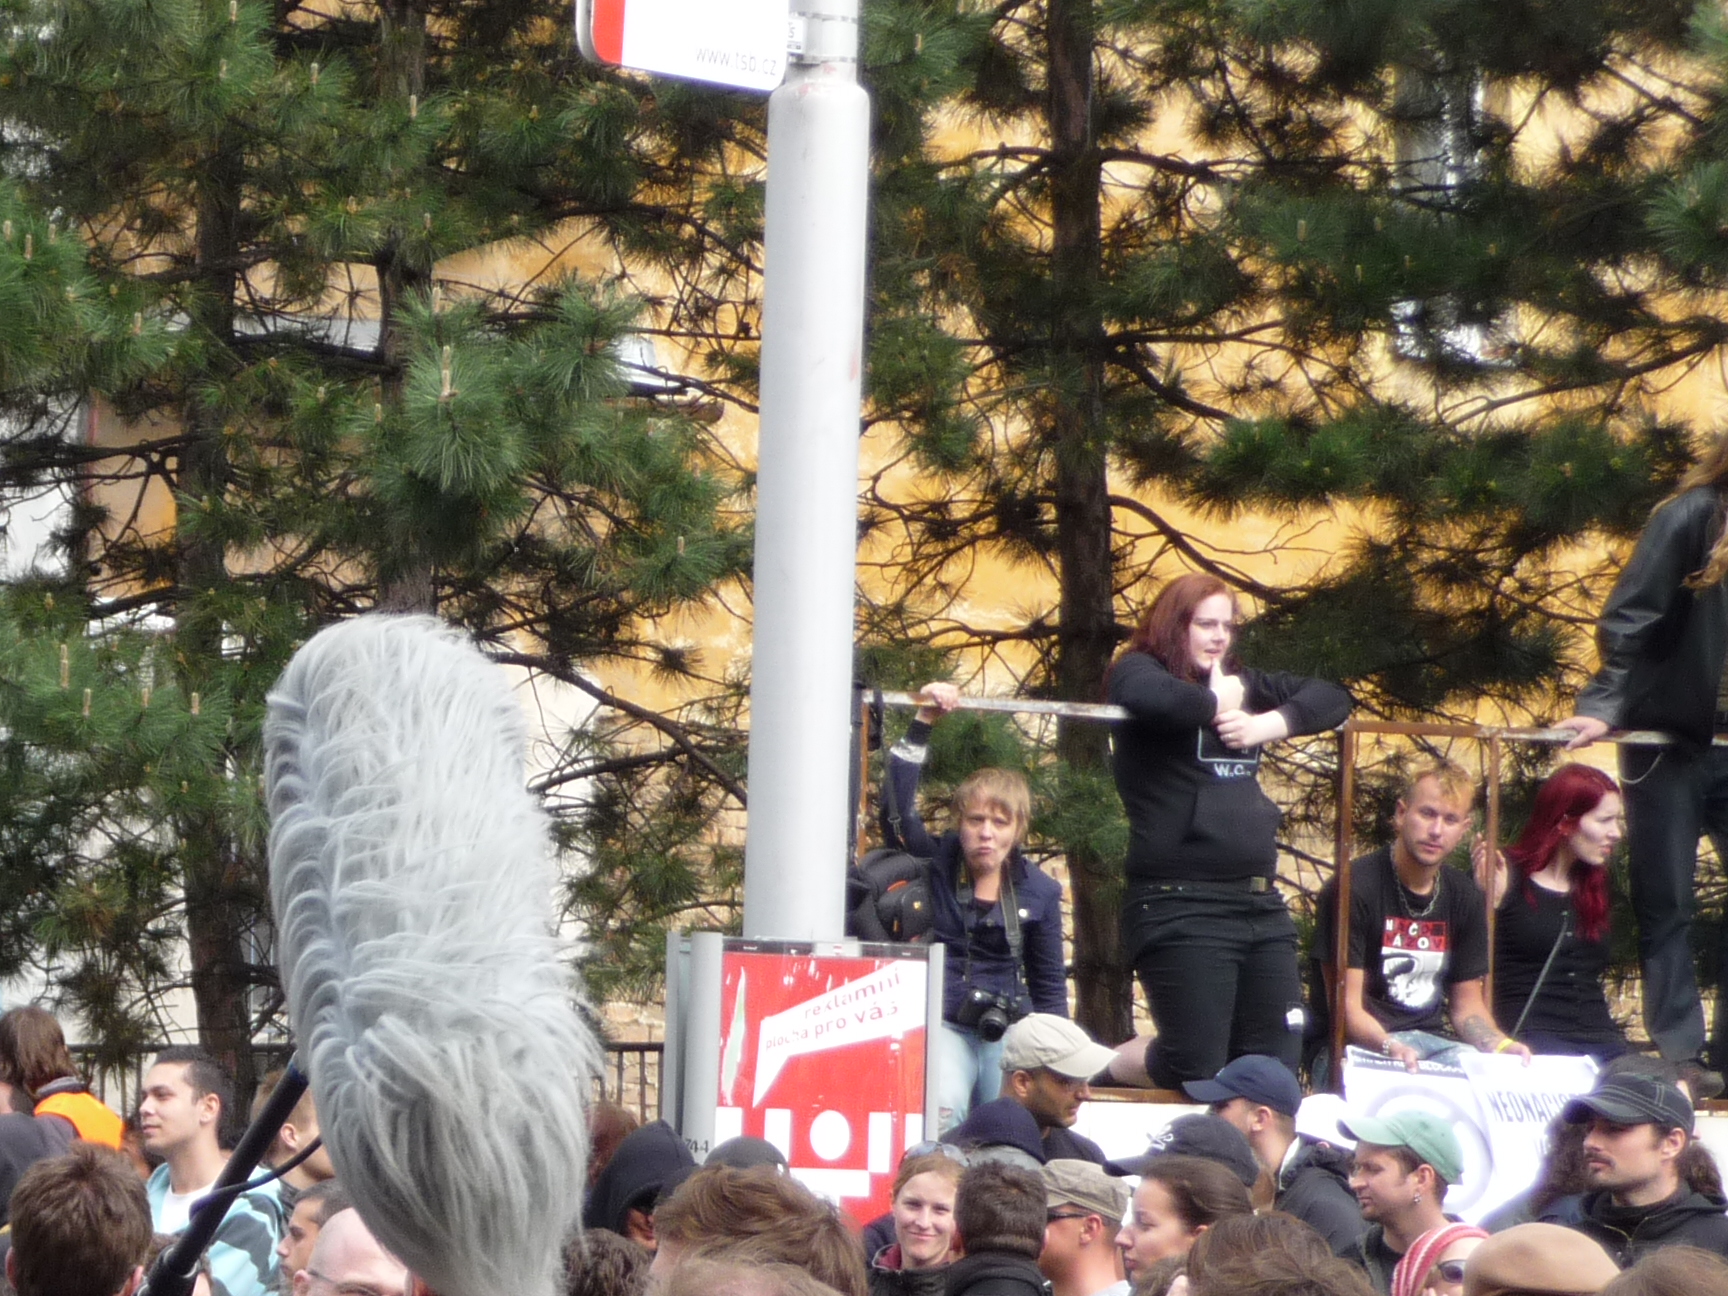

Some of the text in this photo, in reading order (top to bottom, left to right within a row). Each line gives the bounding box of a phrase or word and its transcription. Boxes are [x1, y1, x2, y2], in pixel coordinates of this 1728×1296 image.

[695, 47, 777, 77] www.tsb.cz
[804, 966, 901, 1020] reklamní
[765, 1027, 809, 1051] plocha
[814, 1016, 847, 1040] pro
